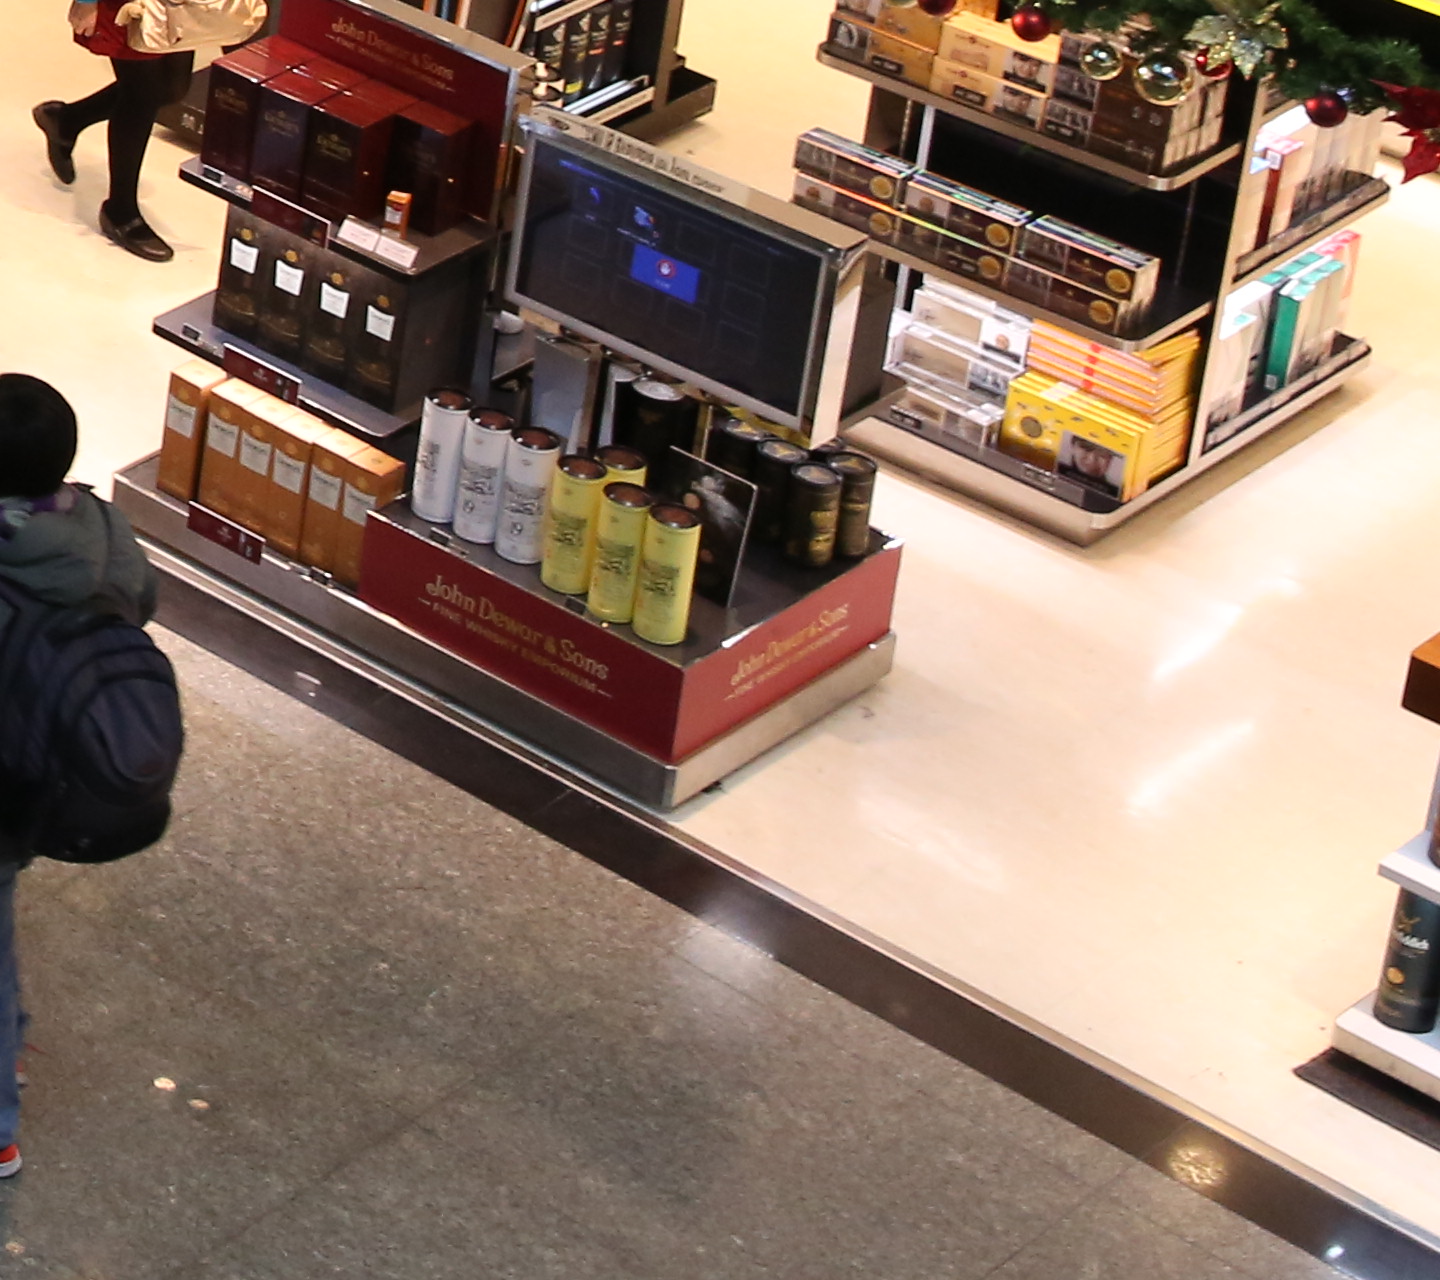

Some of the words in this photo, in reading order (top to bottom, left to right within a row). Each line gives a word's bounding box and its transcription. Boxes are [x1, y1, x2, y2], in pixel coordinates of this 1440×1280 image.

[332, 17, 366, 42] John
[433, 603, 462, 625] FINE
[426, 574, 475, 614] John
[479, 595, 542, 643] Dewar
[560, 636, 609, 681] Sons
